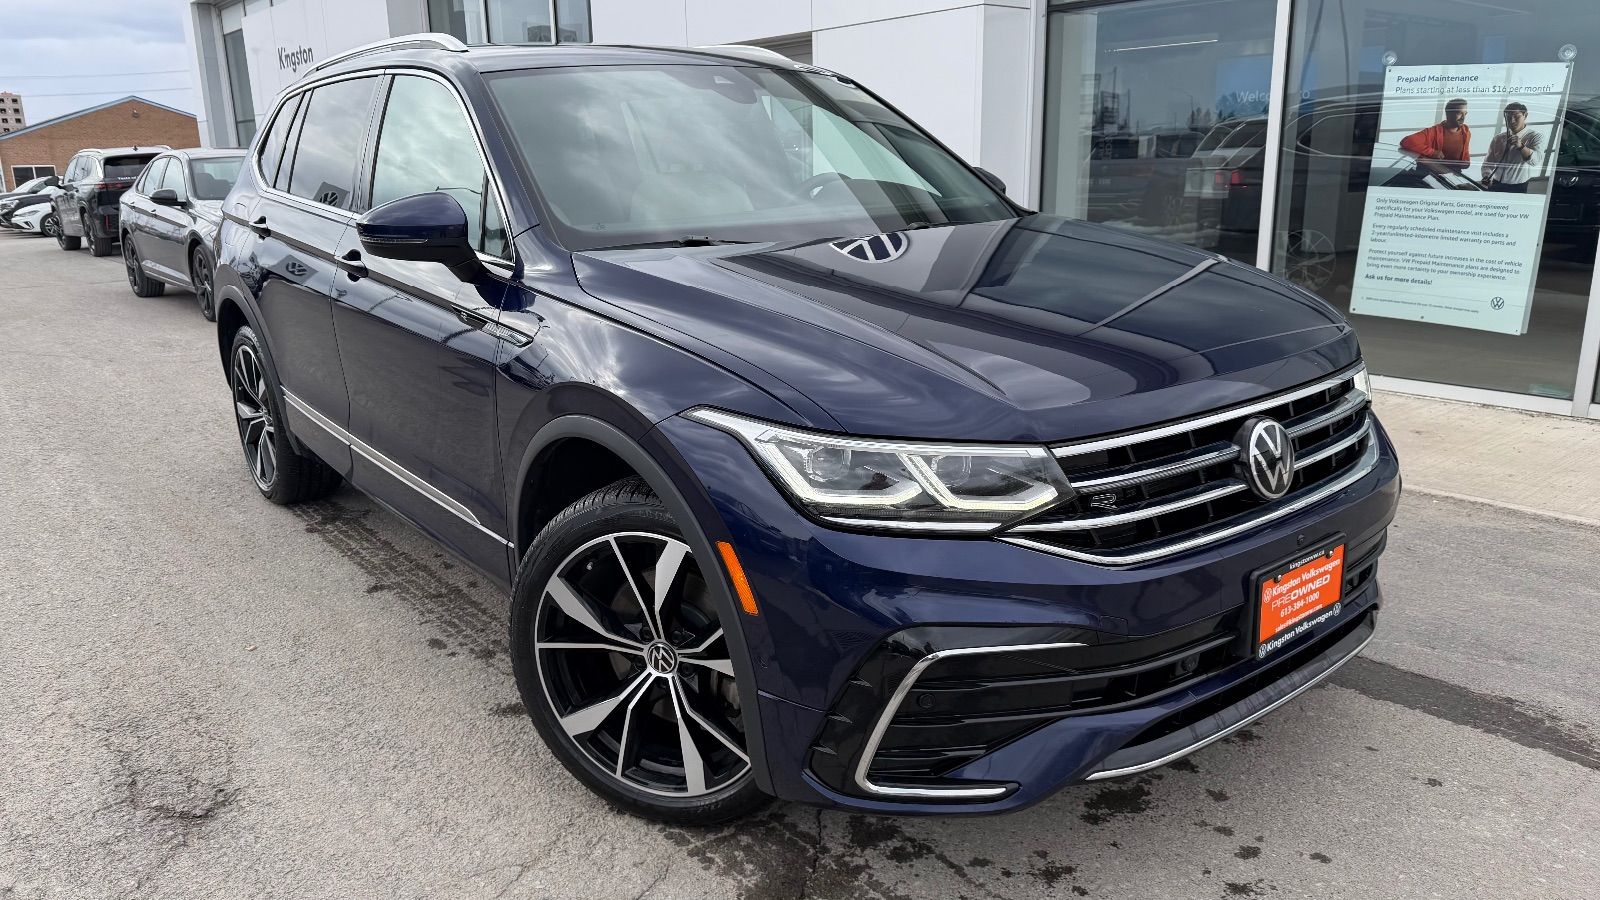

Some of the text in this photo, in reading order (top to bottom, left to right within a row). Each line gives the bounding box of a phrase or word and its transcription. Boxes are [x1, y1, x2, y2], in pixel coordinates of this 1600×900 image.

[278, 45, 314, 72] Kingston
[1397, 75, 1426, 84] Prepaid
[1236, 90, 1270, 102] Welc
[1416, 86, 1444, 95] starting
[1508, 86, 1522, 94] per
[1456, 202, 1508, 210] German-engineered
[1432, 260, 1464, 268] Maintenance
[1272, 577, 1300, 597] Kingston
[1301, 558, 1340, 582] Volkswagen
[1280, 592, 1320, 618] 613-384-1000
[1266, 632, 1295, 652] Kingston
[1294, 610, 1333, 635] Volkswagen
